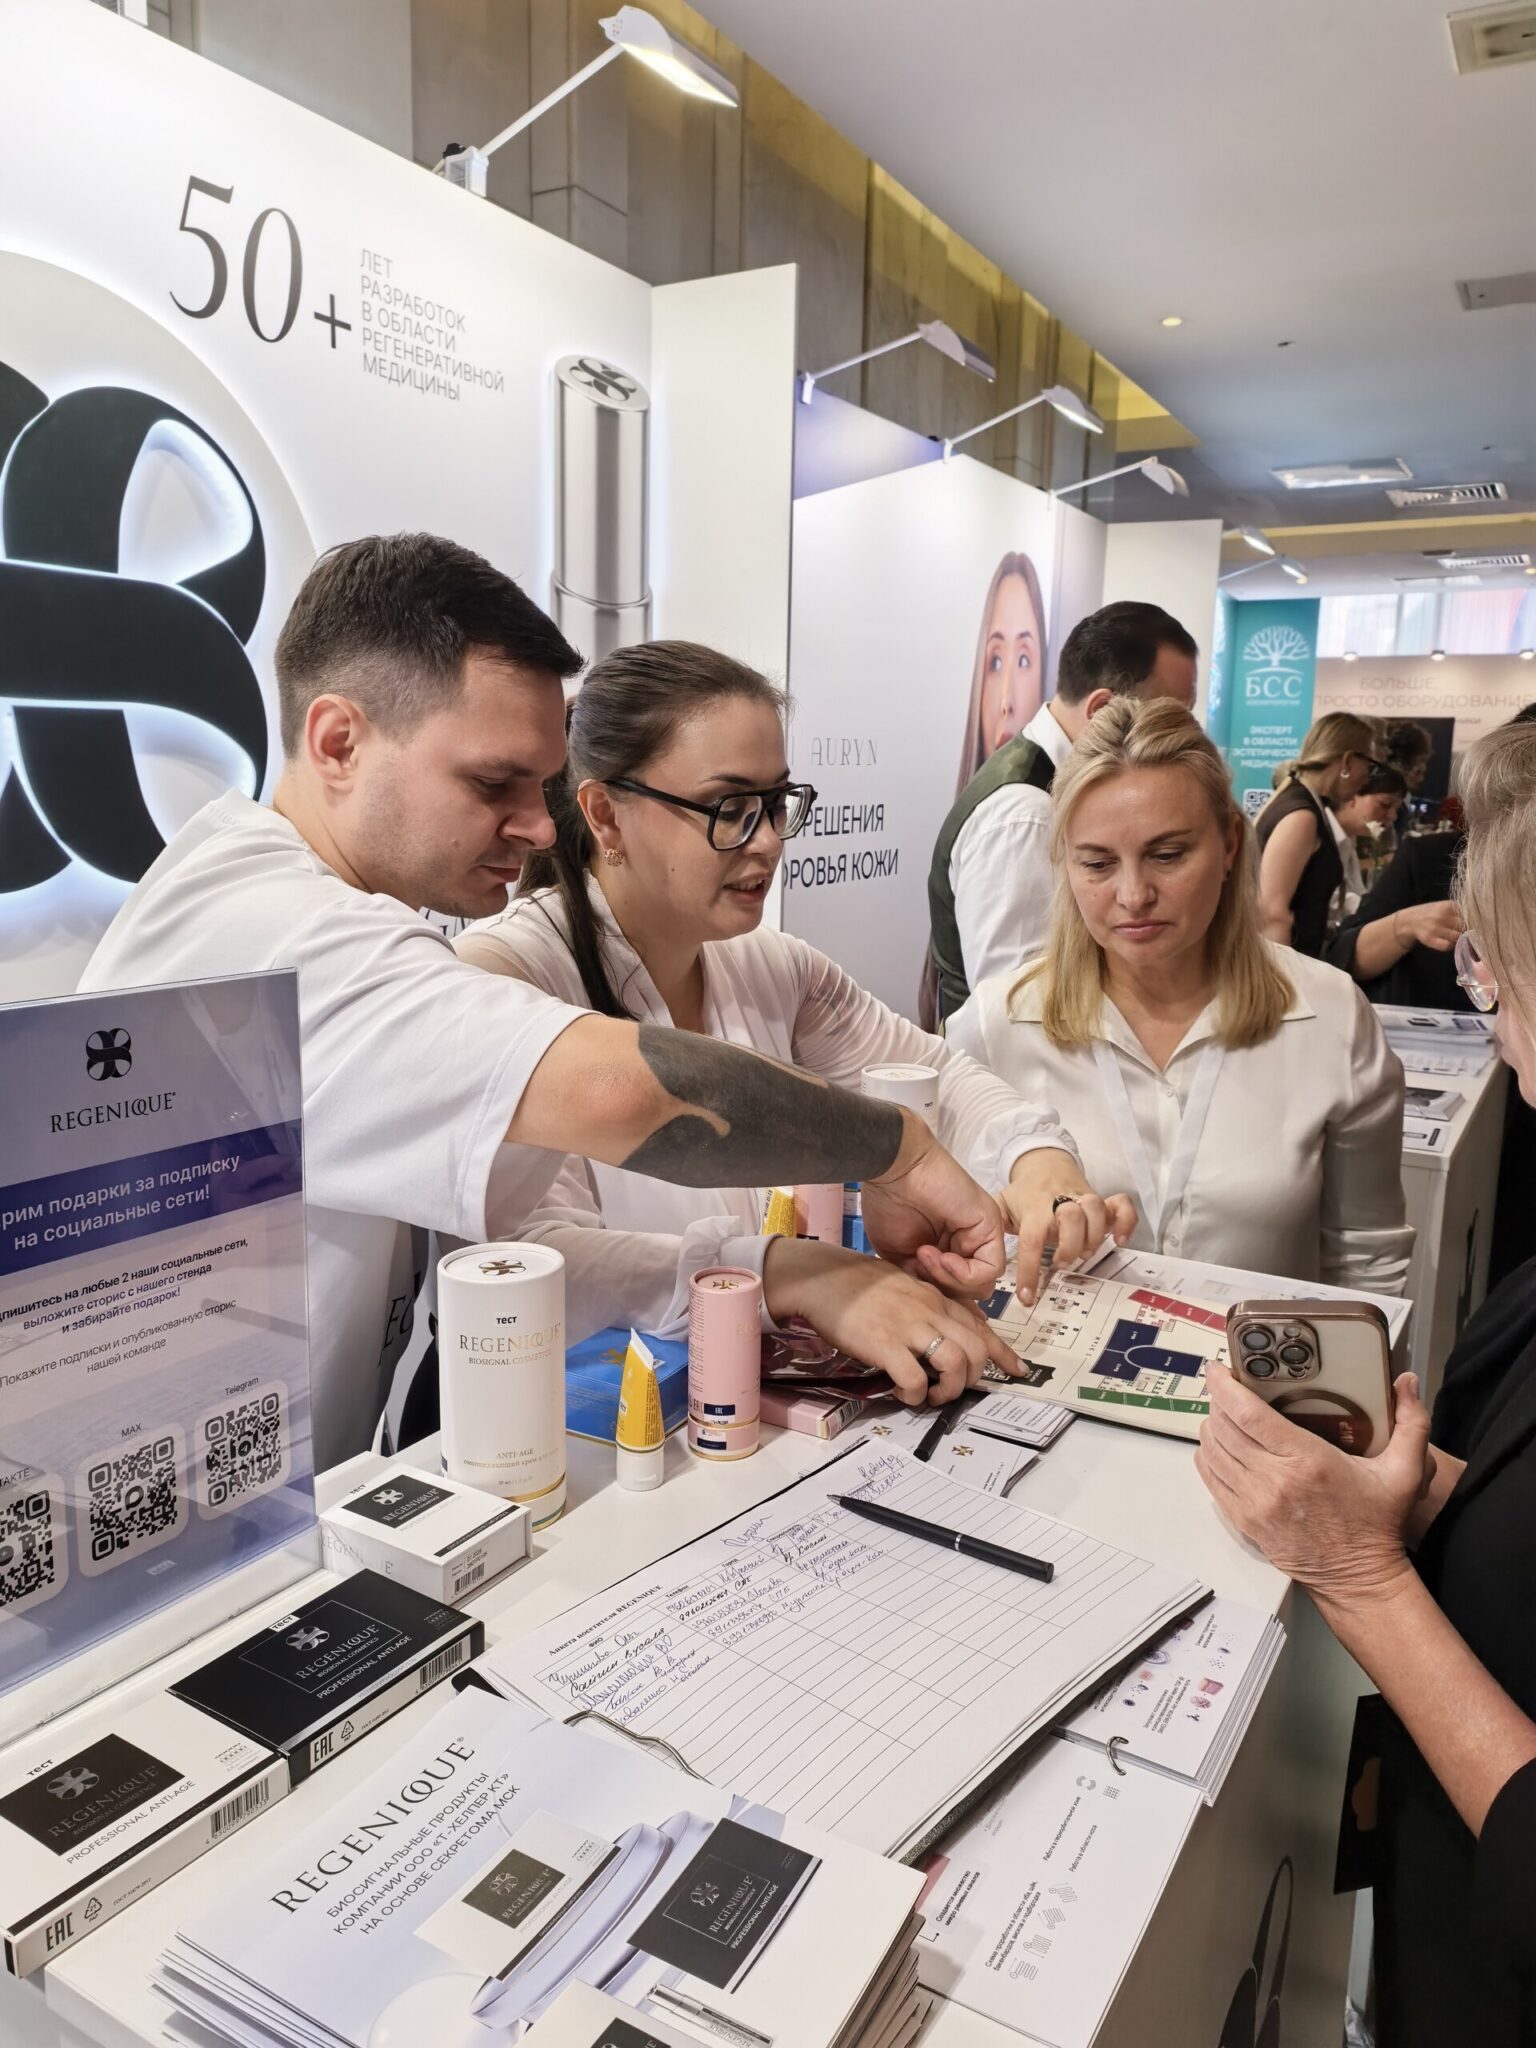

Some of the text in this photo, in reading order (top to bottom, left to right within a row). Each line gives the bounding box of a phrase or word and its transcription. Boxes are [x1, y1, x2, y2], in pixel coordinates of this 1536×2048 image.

[169, 175, 352, 349] 50+
[360, 248, 393, 280] ЛЕТ
[360, 275, 466, 334] РАЗРАБОТОК
[361, 301, 456, 353] В ОБЛАСТИ
[362, 328, 505, 394] РЕГЕНЕРАТИВНОЙ
[362, 353, 461, 401] МЕДИЦИНЫ
[1246, 676, 1302, 698] БСС
[1317, 694, 1379, 709] ПРОСТО
[1360, 677, 1435, 691] БОЛЬШЕ
[1243, 737, 1298, 746] В ОБЛАСТИ
[1249, 725, 1293, 735] ЭКСПЕРТ
[811, 737, 878, 766] AURYN
[803, 804, 884, 837] РЕШЕНИЯ
[851, 848, 899, 881] КОЖИ
[0, 1155, 240, 1230] рим подарки за подписку
[14, 1184, 211, 1250] на социальные сети!
[0, 1238, 248, 1321] пишитесь на любые 2 наши социальные сети,
[23, 1263, 212, 1330] выложите сторис с нашего стенда
[62, 1287, 181, 1334] и забирайте подарок!
[496, 1316, 518, 1325] тест
[0, 1300, 237, 1388] Покажите подписки и опубликованную сторис
[87, 1338, 167, 1373] нашей команде
[468, 1357, 511, 1366] BIOSIGNAL
[225, 1377, 259, 1396] Telegram
[121, 1423, 142, 1438] MAX
[496, 1448, 535, 1459] ANTI-AGE
[350, 1484, 367, 1495] тест
[666, 1585, 689, 1599] Телефон
[272, 1616, 293, 1630] тест
[549, 1585, 663, 1656] Анкета посетителя REGENIQUE
[347, 1637, 379, 1658] COSMETICS
[588, 1637, 604, 1648] ФИО
[316, 1658, 378, 1699] PROFESSIONAL
[377, 1634, 413, 1660] ANTI-AGE
[314, 1732, 334, 1763] EAC
[26, 1759, 54, 1777] тест
[67, 1811, 148, 1864] PROFESSIONAL
[149, 1780, 196, 1813] ANTI-AGE
[326, 1823, 433, 1919] БИОСИГНАЛЬНЫЕ
[429, 1772, 489, 1828] ПРОДУКТЫ
[333, 1772, 509, 1935] КОМПАНИИ ООО «Т-ХЕЛПЕР КТ»
[360, 1785, 522, 1935] НА ОСНОВЕ СЕКРЕТОМА МСК
[936, 1870, 970, 1921] Создается множество
[945, 1871, 980, 1926] микро раневых каналов
[1023, 1891, 1041, 1920] подбородка
[46, 1912, 74, 1952] EAC
[730, 1909, 761, 1949] PROFESSIONAL
[760, 1884, 779, 1910] ANTI-AGE
[985, 1950, 998, 1967] Схема
[995, 1923, 1013, 1953] проработки
[1013, 1901, 1026, 1920] области
